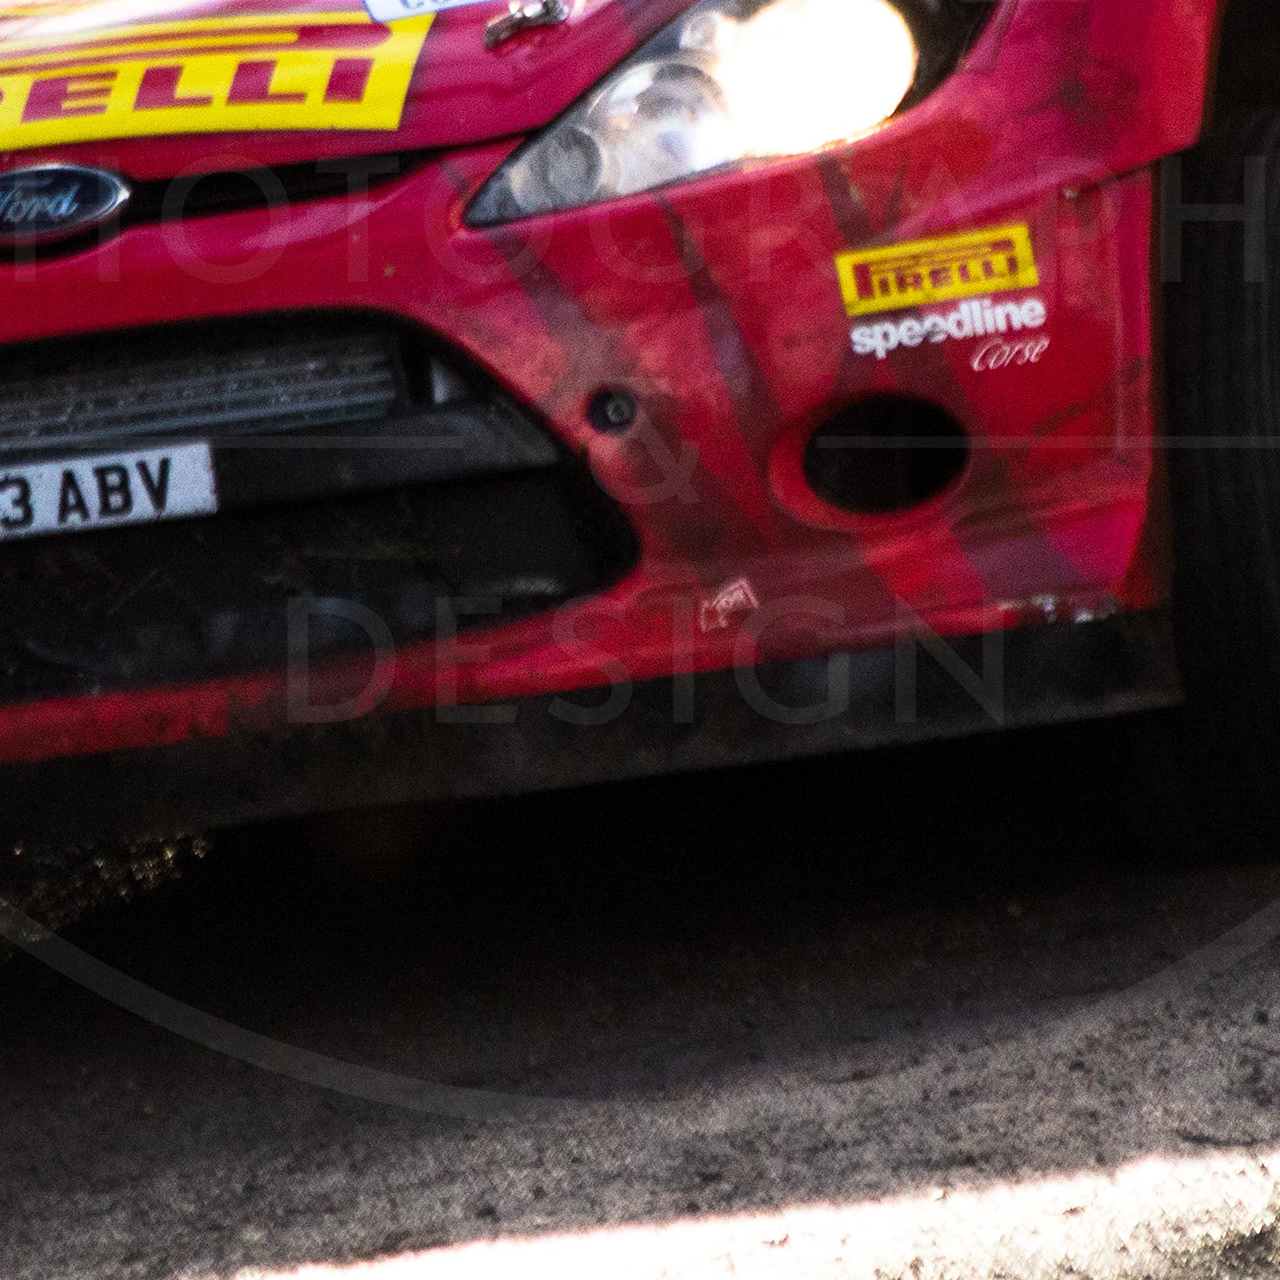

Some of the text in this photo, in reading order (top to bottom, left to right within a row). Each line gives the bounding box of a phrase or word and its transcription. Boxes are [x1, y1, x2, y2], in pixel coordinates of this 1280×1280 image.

[850, 298, 1046, 359] speedline
[972, 336, 1050, 371] Corse
[57, 457, 171, 524] ABV
